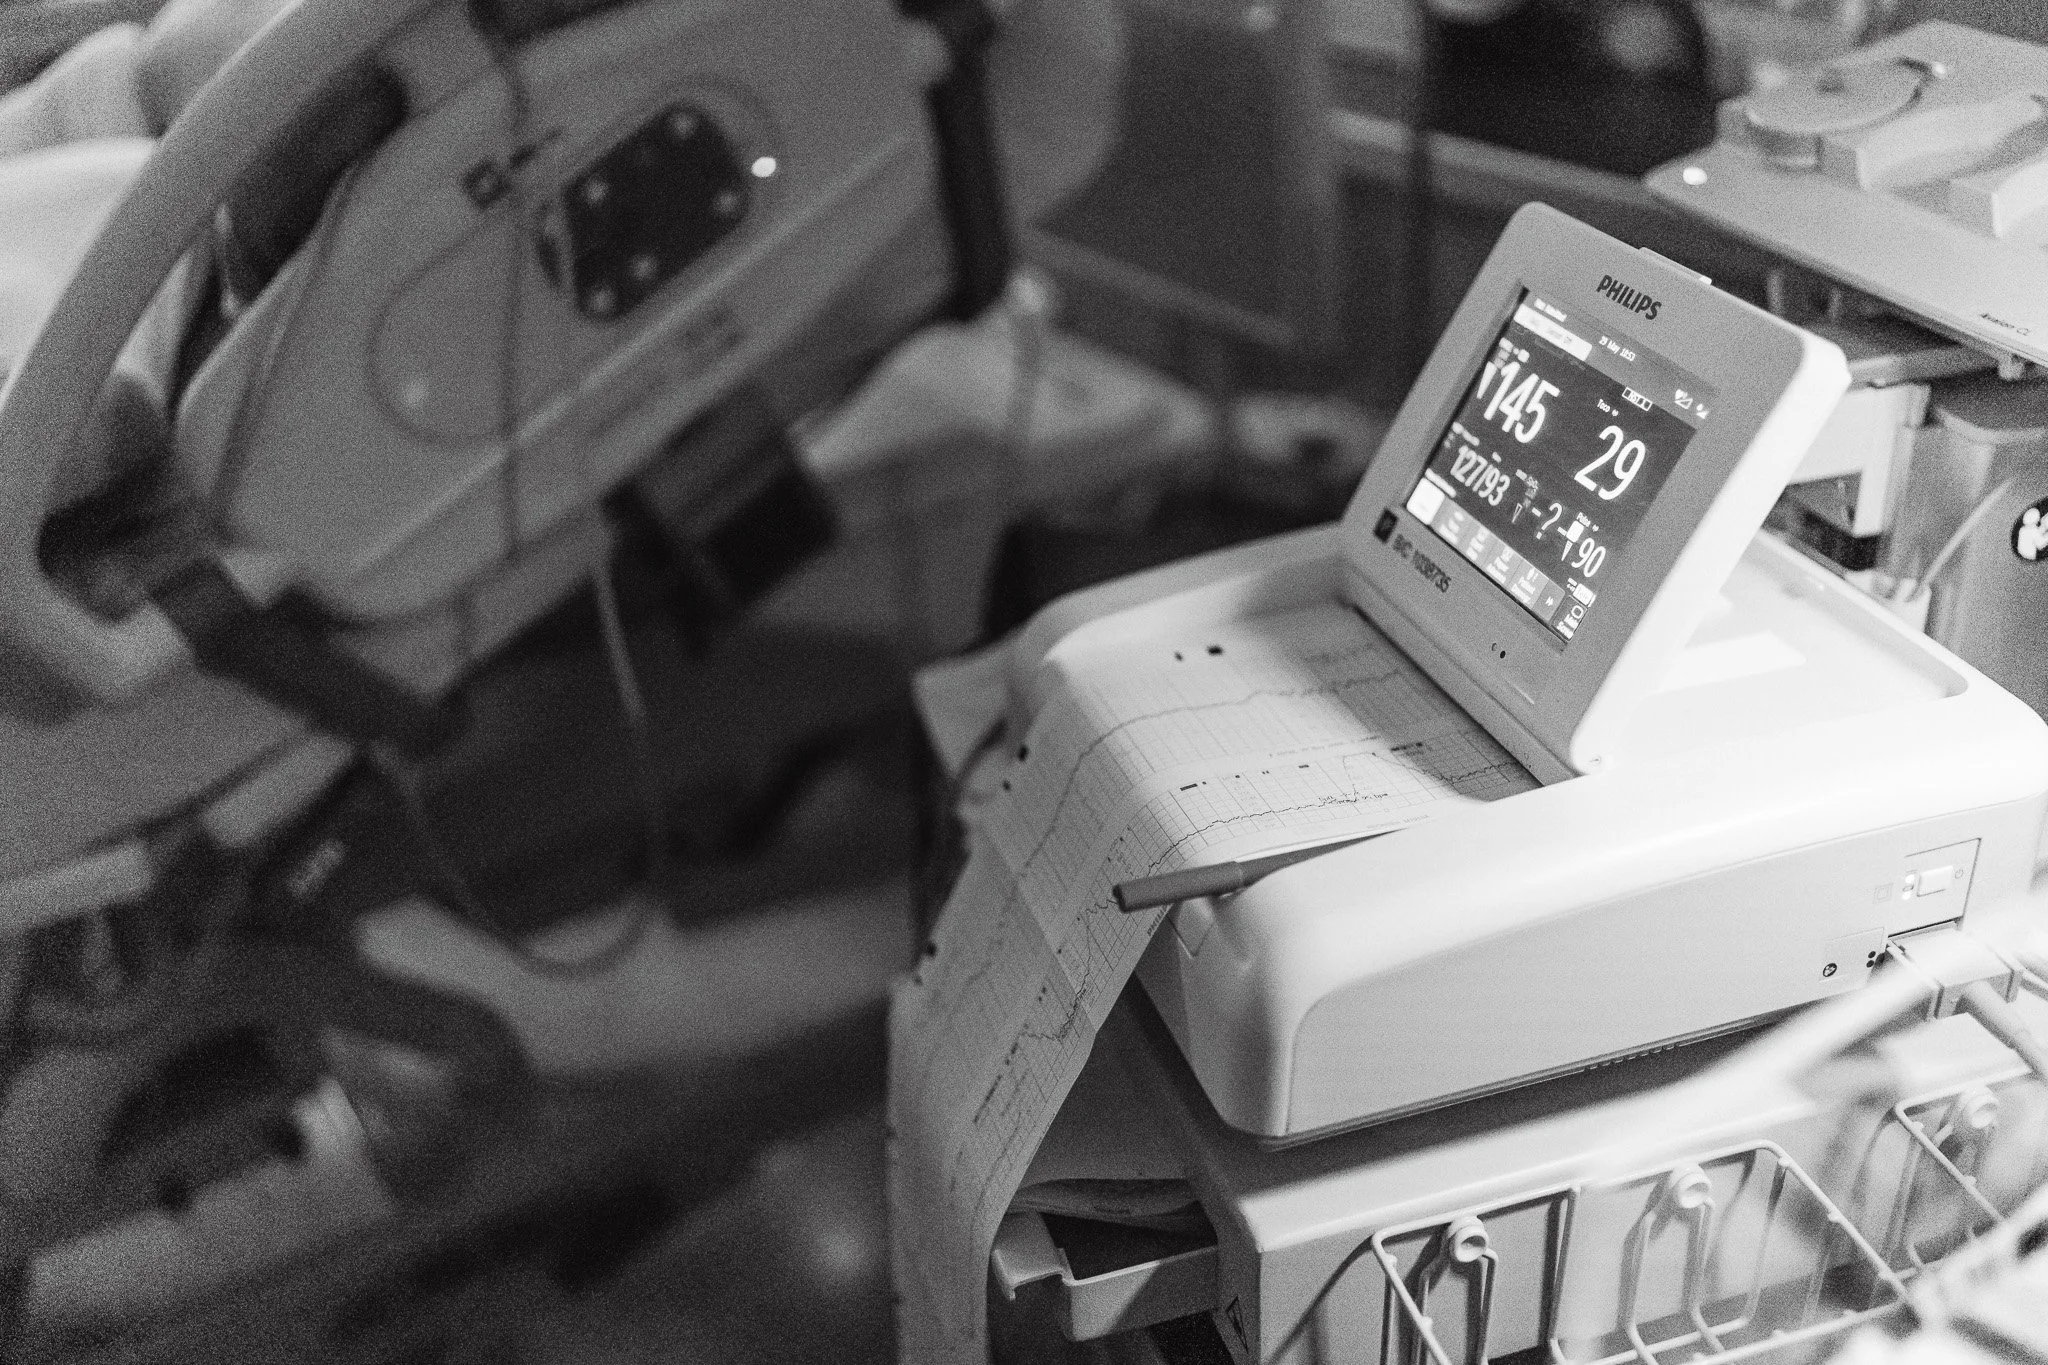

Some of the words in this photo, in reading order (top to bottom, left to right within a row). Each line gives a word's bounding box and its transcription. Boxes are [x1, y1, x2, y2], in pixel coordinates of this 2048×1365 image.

[1596, 274, 1662, 320] PHILIPS
[1483, 361, 1560, 443] 145
[1597, 398, 1611, 413] Toco
[1450, 445, 1511, 506] 127/93
[1574, 425, 1646, 500] 29
[1571, 537, 1606, 578] 90
